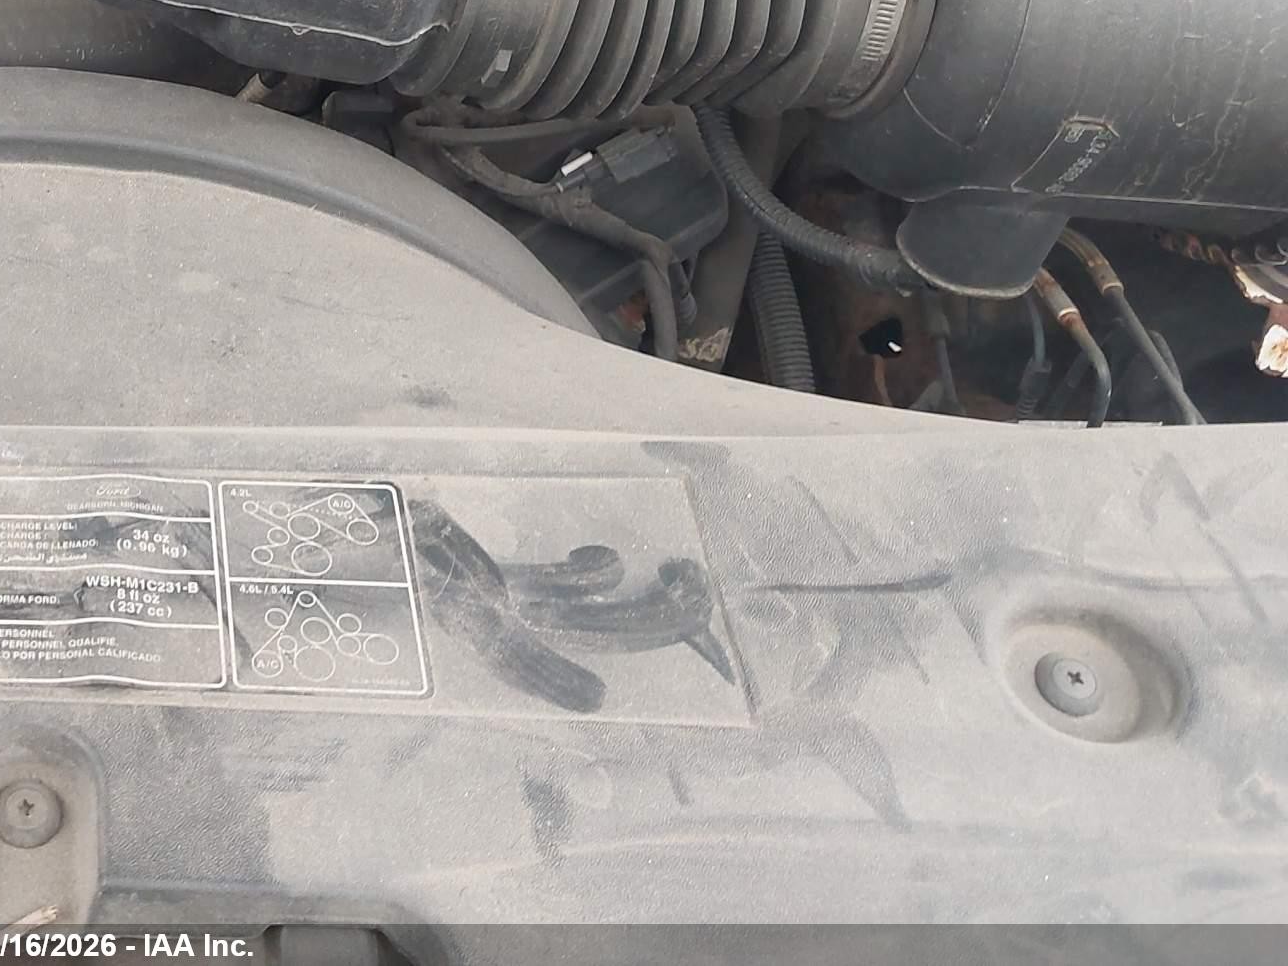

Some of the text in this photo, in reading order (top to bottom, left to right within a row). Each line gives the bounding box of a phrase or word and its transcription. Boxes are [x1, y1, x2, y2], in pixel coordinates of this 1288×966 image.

[230, 488, 252, 497] 4.2L
[332, 499, 352, 509] A/C
[0, 522, 42, 531] CHARGE
[0, 532, 42, 540] CHARGE
[133, 528, 170, 544] 34 oz
[0, 541, 34, 549] CARGA
[35, 541, 49, 549] DE
[86, 575, 199, 594] WSH-M1C231-B
[239, 584, 262, 594] 4.6L
[117, 588, 161, 605] 8 fl oz
[1, 639, 66, 650] PERSONNEL
[13, 650, 36, 660] POR
[38, 647, 95, 661] PERSONAL
[257, 658, 280, 669] A/C
